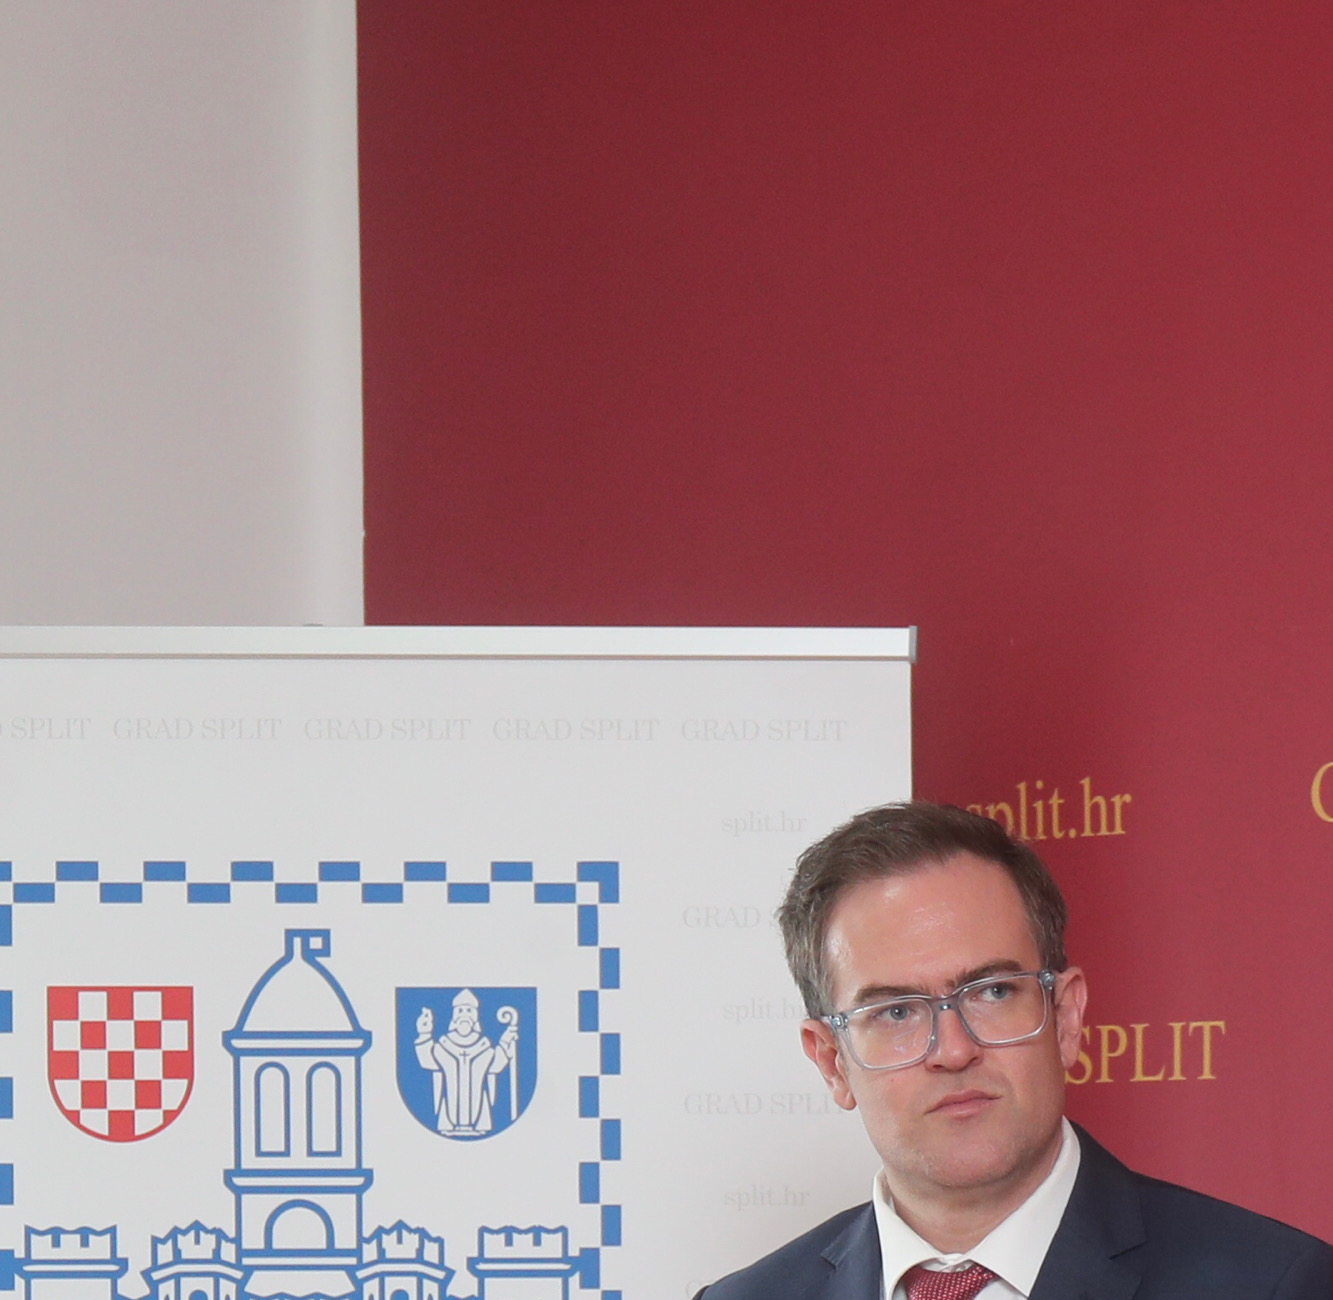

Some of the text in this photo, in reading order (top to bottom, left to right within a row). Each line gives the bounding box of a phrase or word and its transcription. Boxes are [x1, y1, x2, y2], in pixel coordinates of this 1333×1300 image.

[113, 717, 282, 740] GRAD SPLIT
[304, 718, 472, 740] GRAD SPLIT
[492, 718, 660, 741] GRAD SPLIT
[680, 718, 848, 742] GRAD SPLIT
[1064, 1020, 1226, 1086] SPLIT
